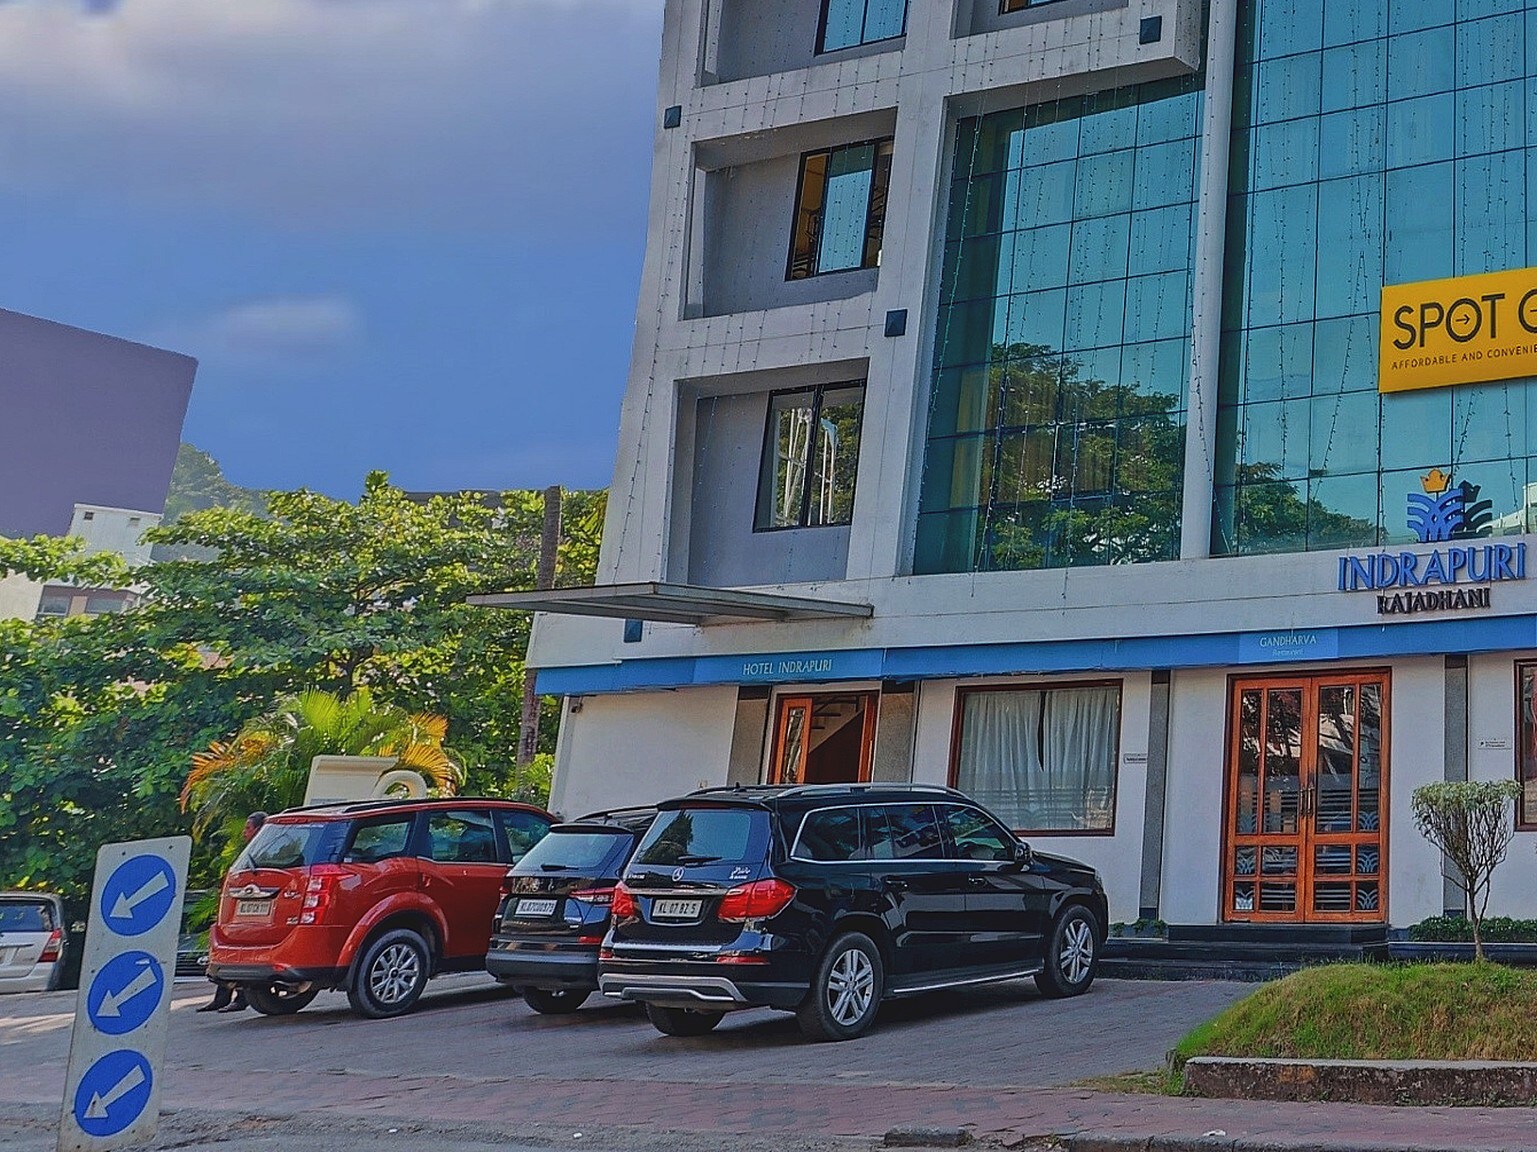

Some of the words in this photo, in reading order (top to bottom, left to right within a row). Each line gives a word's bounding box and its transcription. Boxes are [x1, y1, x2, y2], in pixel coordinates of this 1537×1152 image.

[1393, 293, 1506, 350] SPOT
[1391, 353, 1457, 370] AFFORDABLE
[1461, 350, 1483, 362] AND
[1338, 542, 1527, 591] INDRAPURI
[1377, 587, 1491, 614] RAJADHANI
[1260, 635, 1317, 648] GANDHARVA
[743, 662, 773, 676] HOTEL
[778, 659, 833, 674] INDRAPURI
